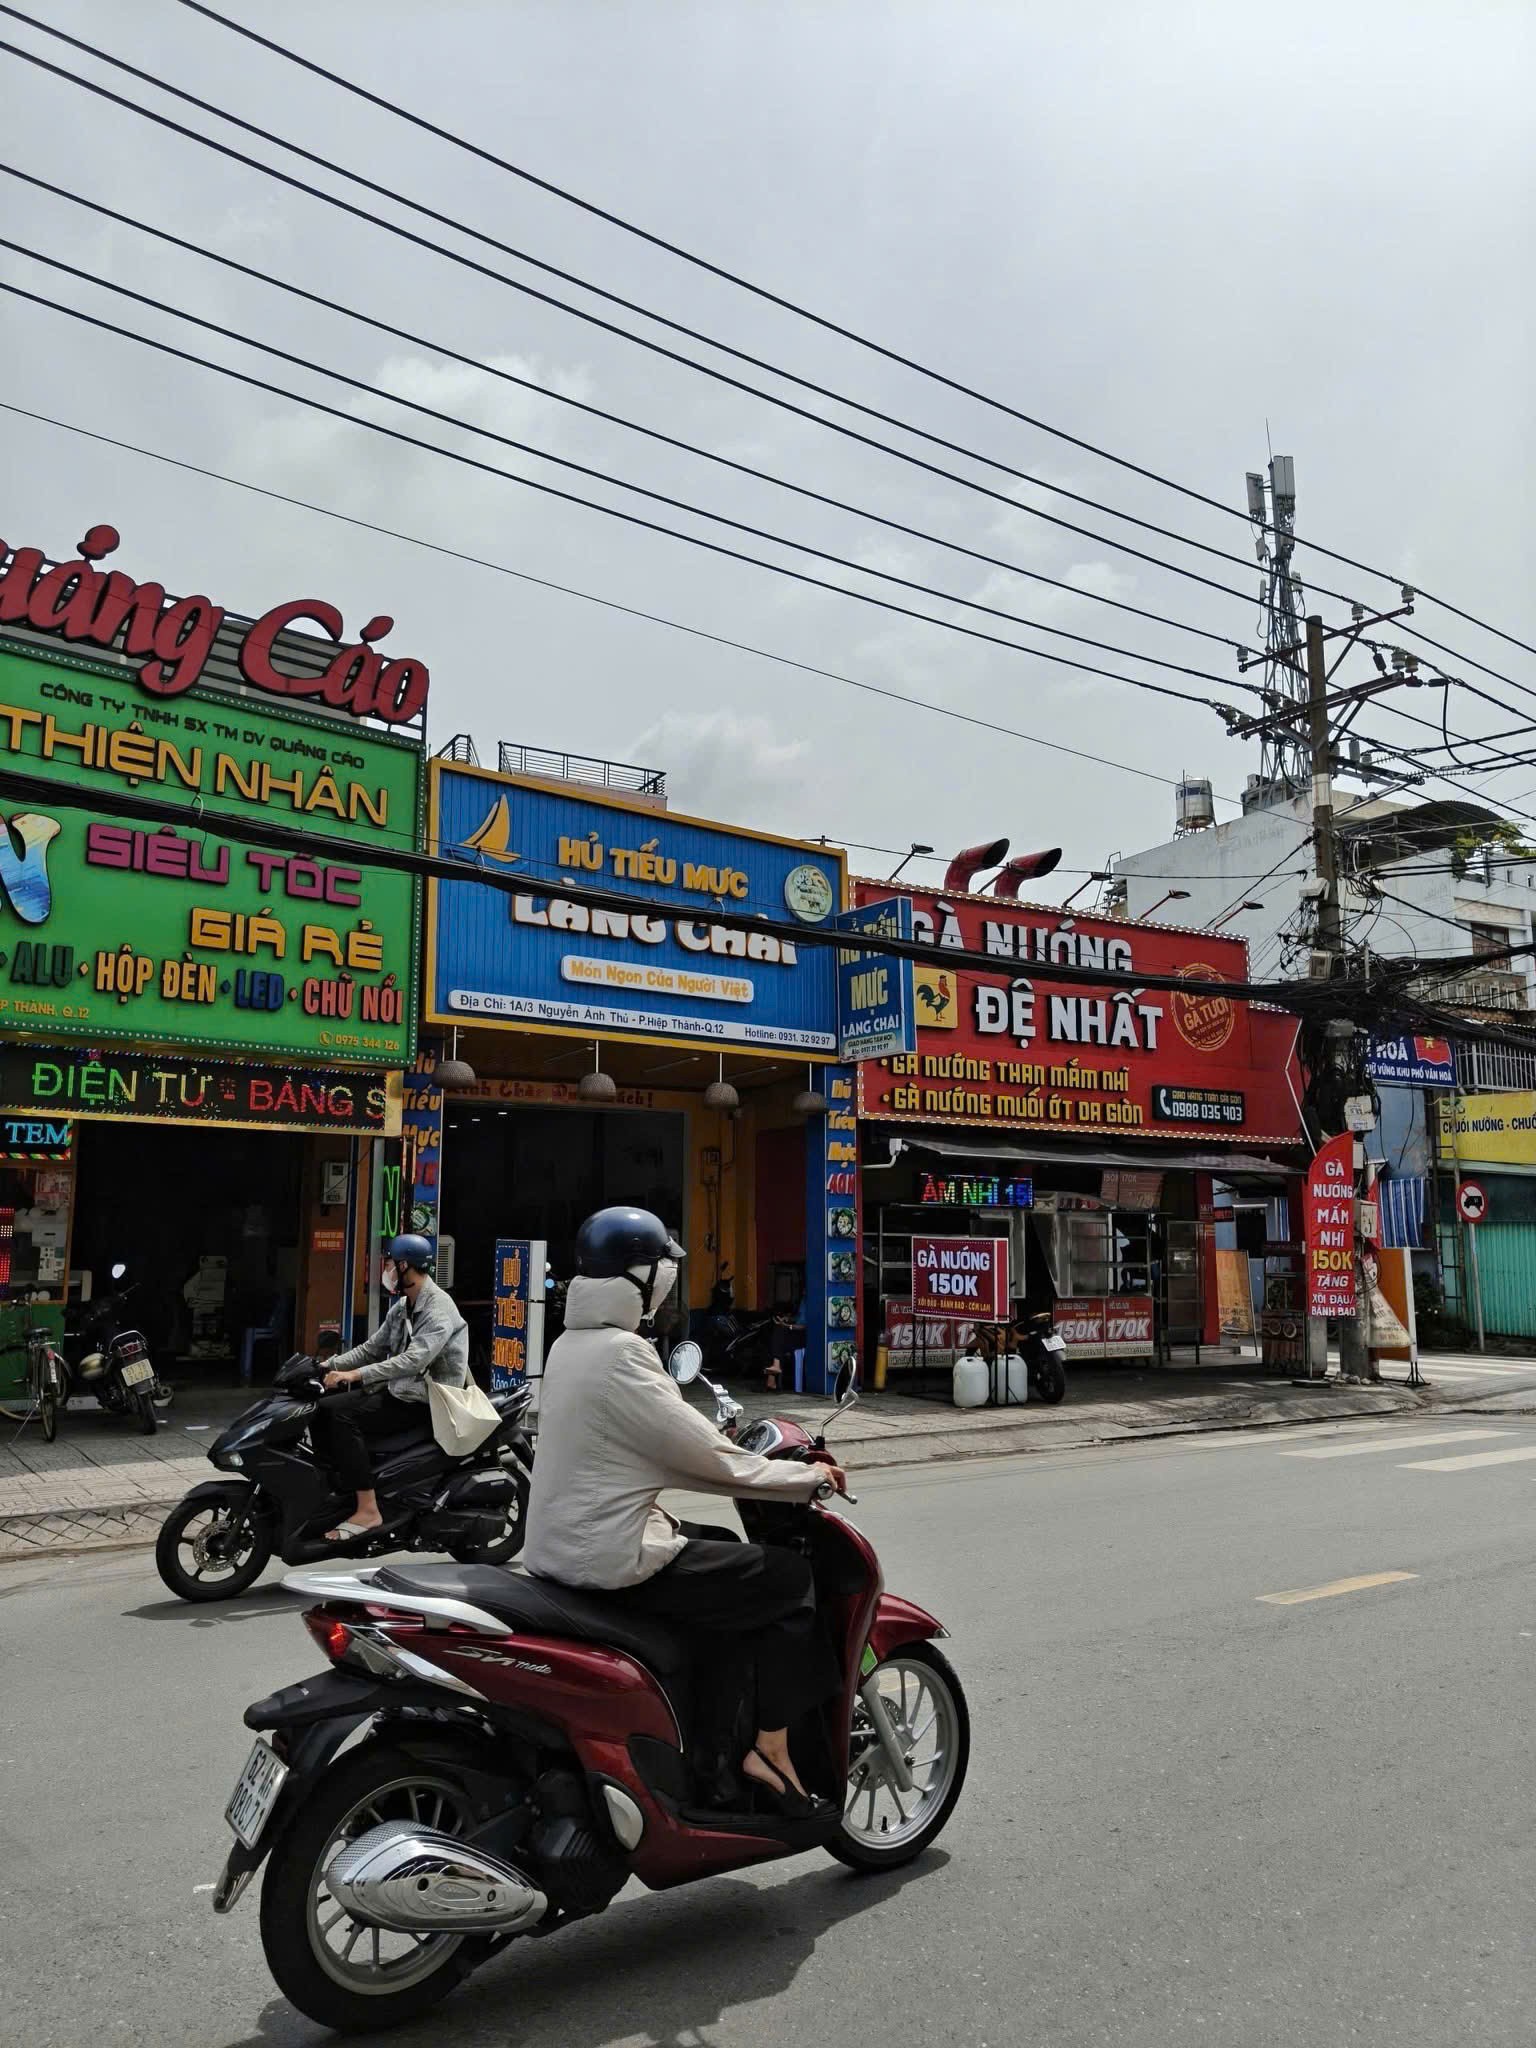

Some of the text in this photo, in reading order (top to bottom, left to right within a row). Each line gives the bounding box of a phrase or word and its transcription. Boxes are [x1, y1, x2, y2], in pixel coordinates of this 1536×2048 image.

[239, 599, 430, 722] Cáo
[40, 682, 365, 770] CÔNG TY TNHH SX TM DV QUẢNG CÁO
[0, 704, 388, 826] THIỆN NHÂN
[87, 825, 229, 884] SIÊU
[246, 852, 362, 906] TỐC
[558, 831, 603, 871] HỦ
[609, 838, 677, 885] TIẾU
[682, 862, 748, 903] MỰC
[191, 907, 384, 971] GIÁ RẺ
[912, 901, 1132, 972] GÀ NƯỚNG
[10, 940, 403, 1025] ALU HỘP ĐÈN LED CHỮ NỔI
[570, 958, 749, 1000] Món Ngon Của Người Việt
[850, 967, 889, 1016] MỰC
[460, 994, 479, 1009] Địa
[509, 1000, 534, 1013] 1A/3
[538, 1004, 579, 1019] Nguyễn
[610, 1011, 629, 1024] Thủ
[744, 1027, 777, 1040] Hotline:
[976, 978, 1037, 1048] ĐỆ
[1051, 988, 1163, 1049] NHẤT
[32, 1060, 138, 1106] ĐIỆN
[152, 1068, 213, 1108] TỬ
[249, 1075, 354, 1117] BẢNG
[924, 1052, 990, 1081] NƯỚNG
[997, 1062, 1044, 1086] THAN
[1103, 1066, 1129, 1092] NHĨ
[1396, 1066, 1410, 1078] KHU
[401, 1083, 442, 1112] Tiếu
[894, 1082, 920, 1109] GÀ
[925, 1086, 991, 1115] NƯỚNG
[997, 1087, 1044, 1118] MUỐI
[1050, 1094, 1073, 1120] ỚT
[1105, 1098, 1144, 1125] GIÒN
[1172, 1102, 1242, 1121] 0988 035 403
[5, 1122, 68, 1145] TEM
[1325, 1158, 1345, 1177] GÀ
[1313, 1181, 1353, 1199] NƯỚNG
[502, 1249, 522, 1287] HỦ
[917, 1244, 990, 1271] GÀ NƯỚNG
[1312, 1249, 1353, 1271] 150K
[928, 1272, 979, 1297] 150K
[1317, 1273, 1349, 1290] TẶNG
[496, 1290, 524, 1329] TIẾU
[1107, 1317, 1150, 1340] 170K
[1311, 1304, 1336, 1316] BÁNH
[1054, 1319, 1103, 1342] 150K
[494, 1337, 525, 1376] MỰC
[515, 1660, 552, 1675] mode
